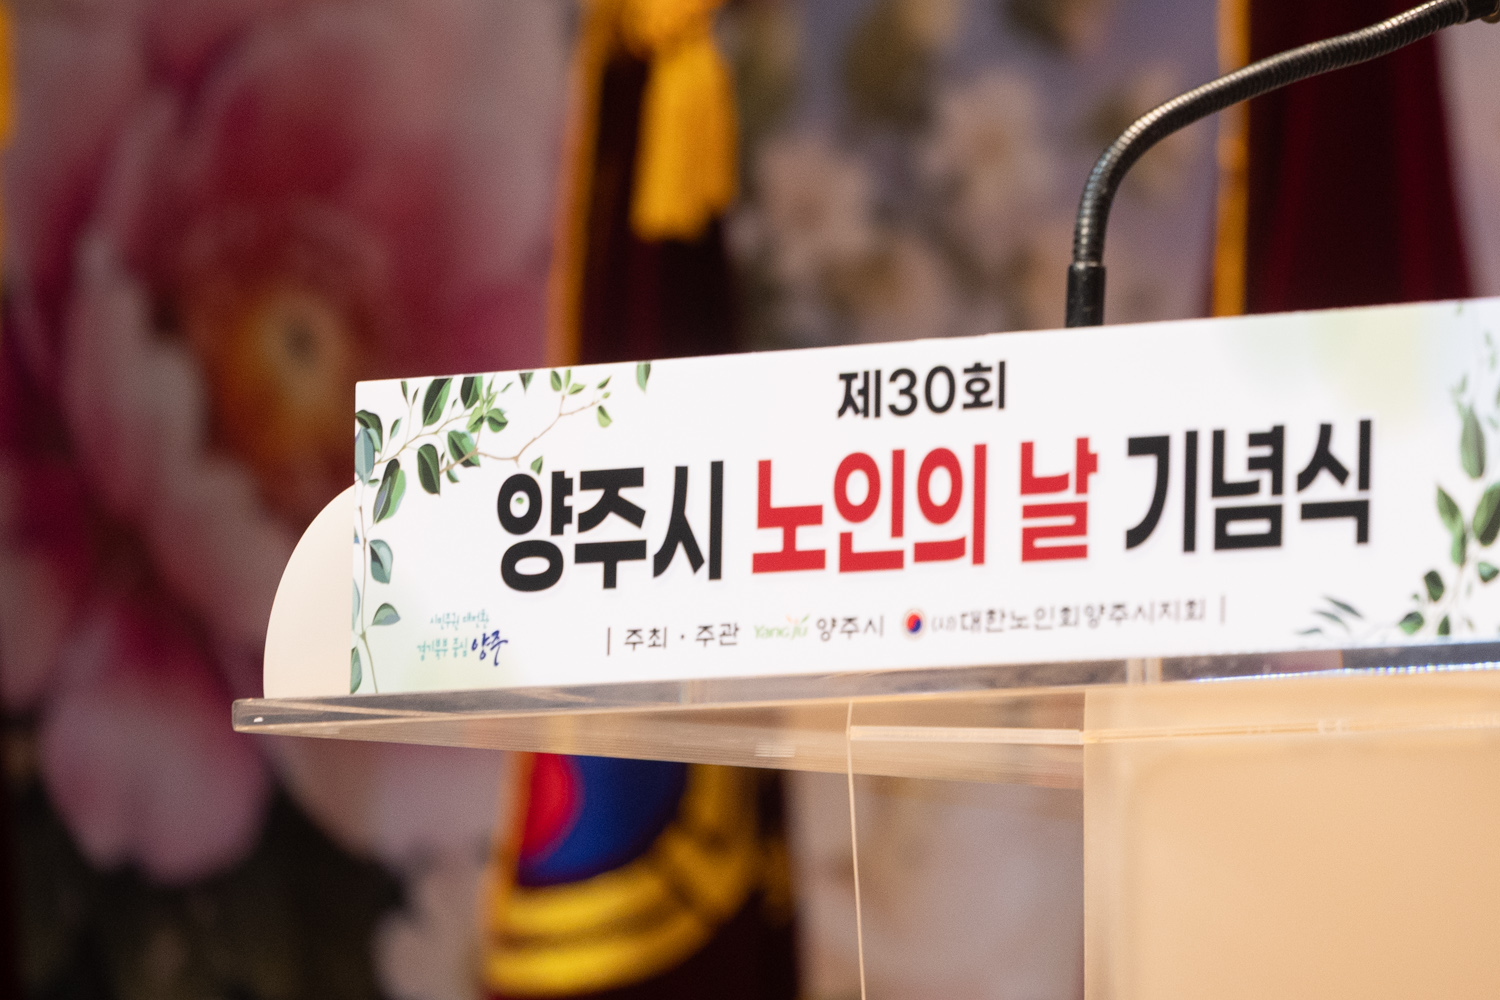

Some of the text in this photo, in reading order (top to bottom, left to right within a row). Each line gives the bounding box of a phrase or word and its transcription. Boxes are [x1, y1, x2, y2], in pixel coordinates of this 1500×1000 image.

[837, 360, 1006, 419] 제30회
[496, 419, 1373, 593] 양주시 노인의 날 기념식
[624, 622, 740, 651] 주최 주관
[815, 614, 885, 642] 양주시
[470, 629, 509, 667] 양주
